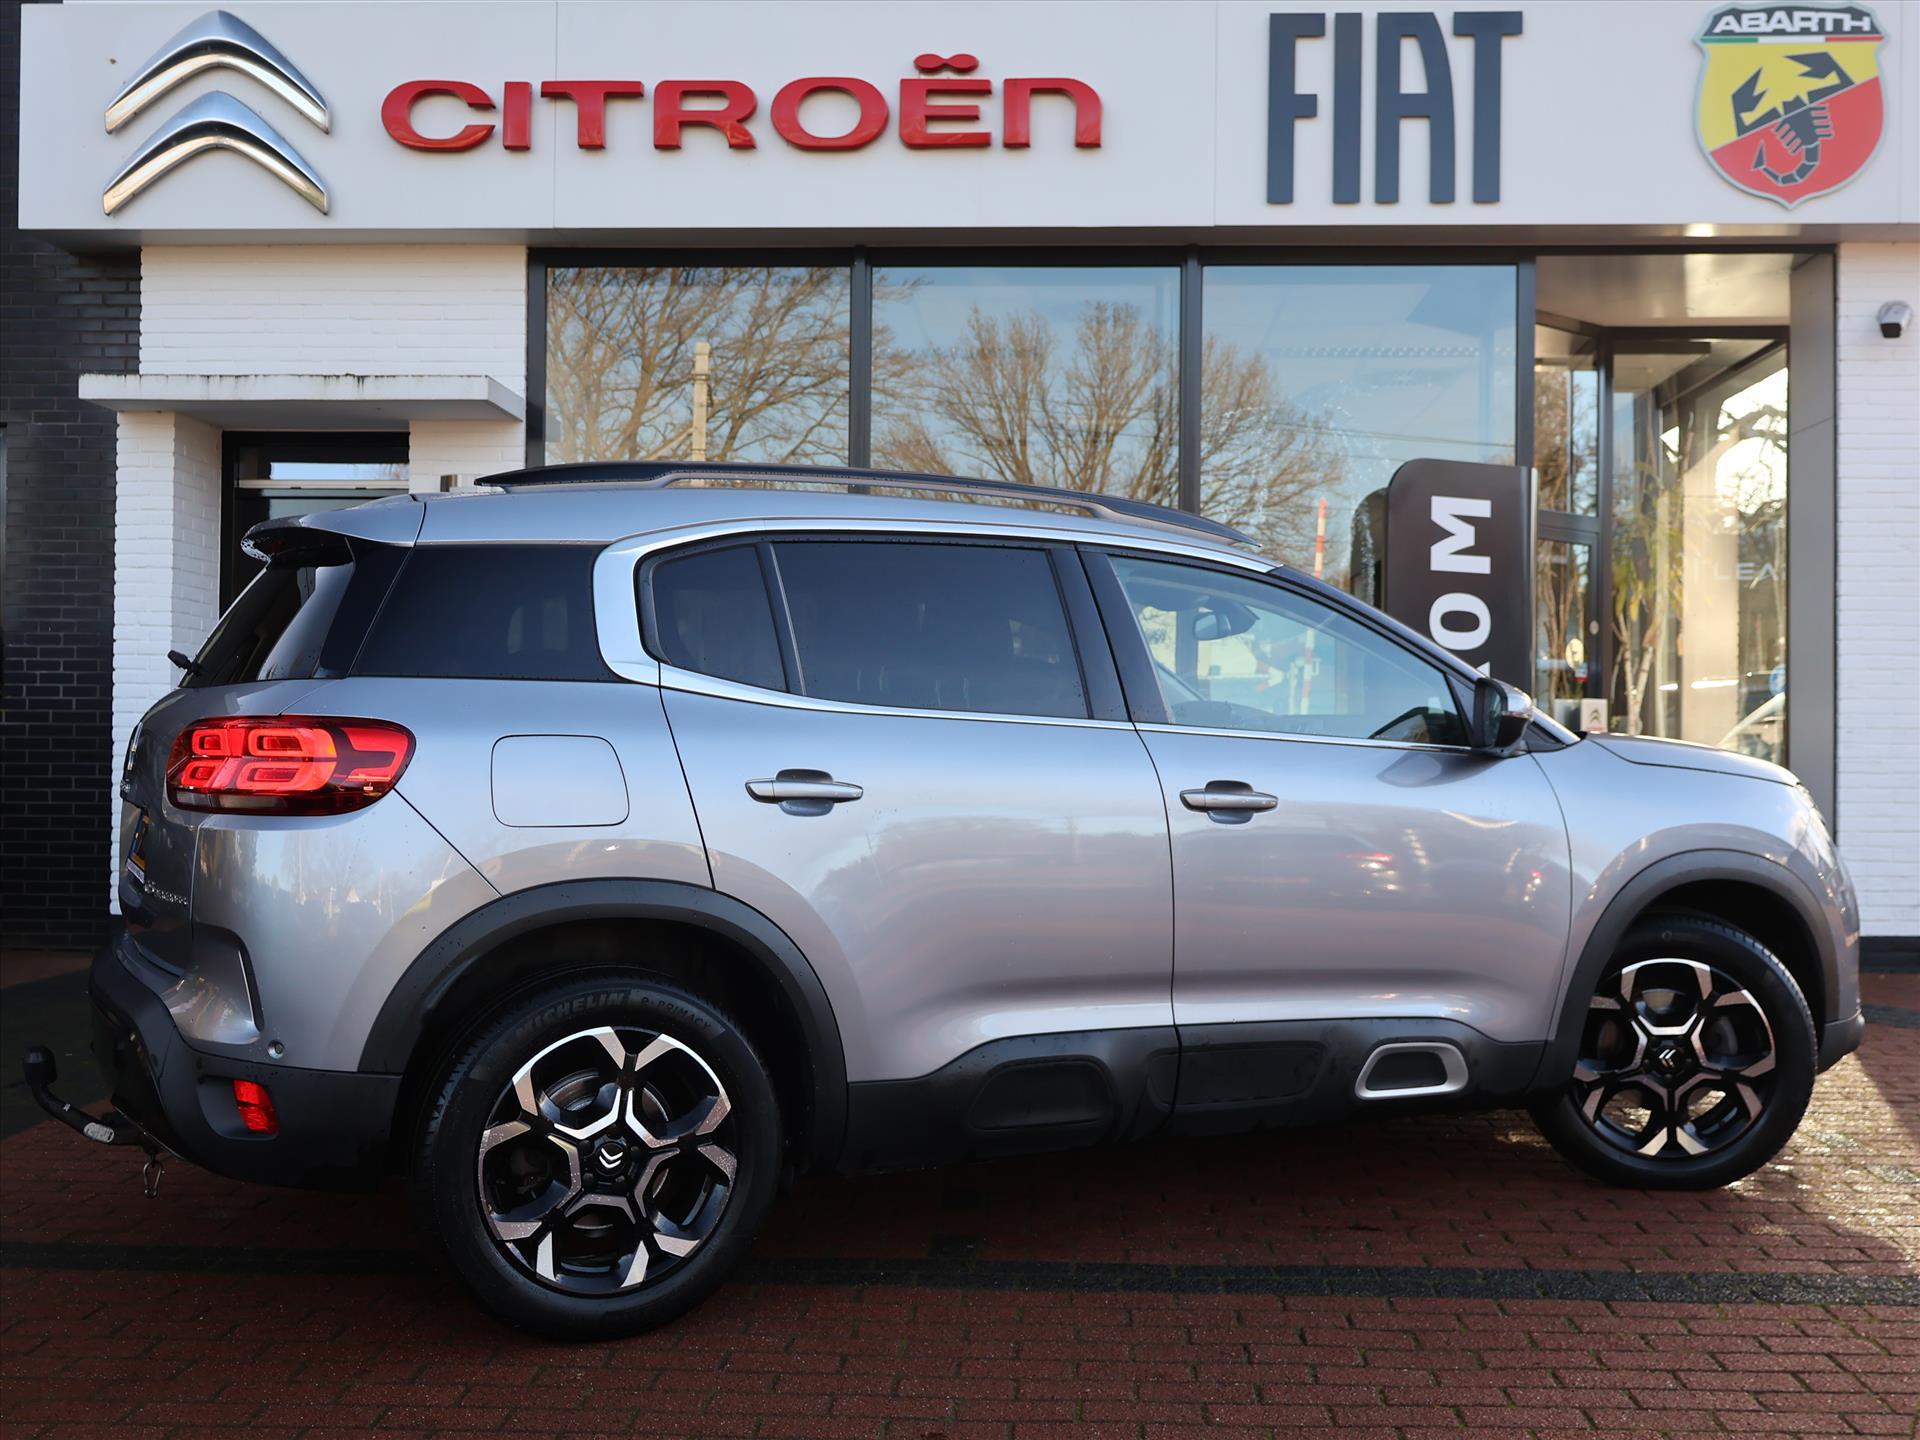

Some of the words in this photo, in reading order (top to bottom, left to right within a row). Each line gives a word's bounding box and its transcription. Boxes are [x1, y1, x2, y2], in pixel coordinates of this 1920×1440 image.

[1712, 10, 1872, 34] ABARTH
[381, 53, 1102, 153] CITROËN
[1266, 10, 1524, 205] FIAT
[1429, 495, 1492, 678] OM
